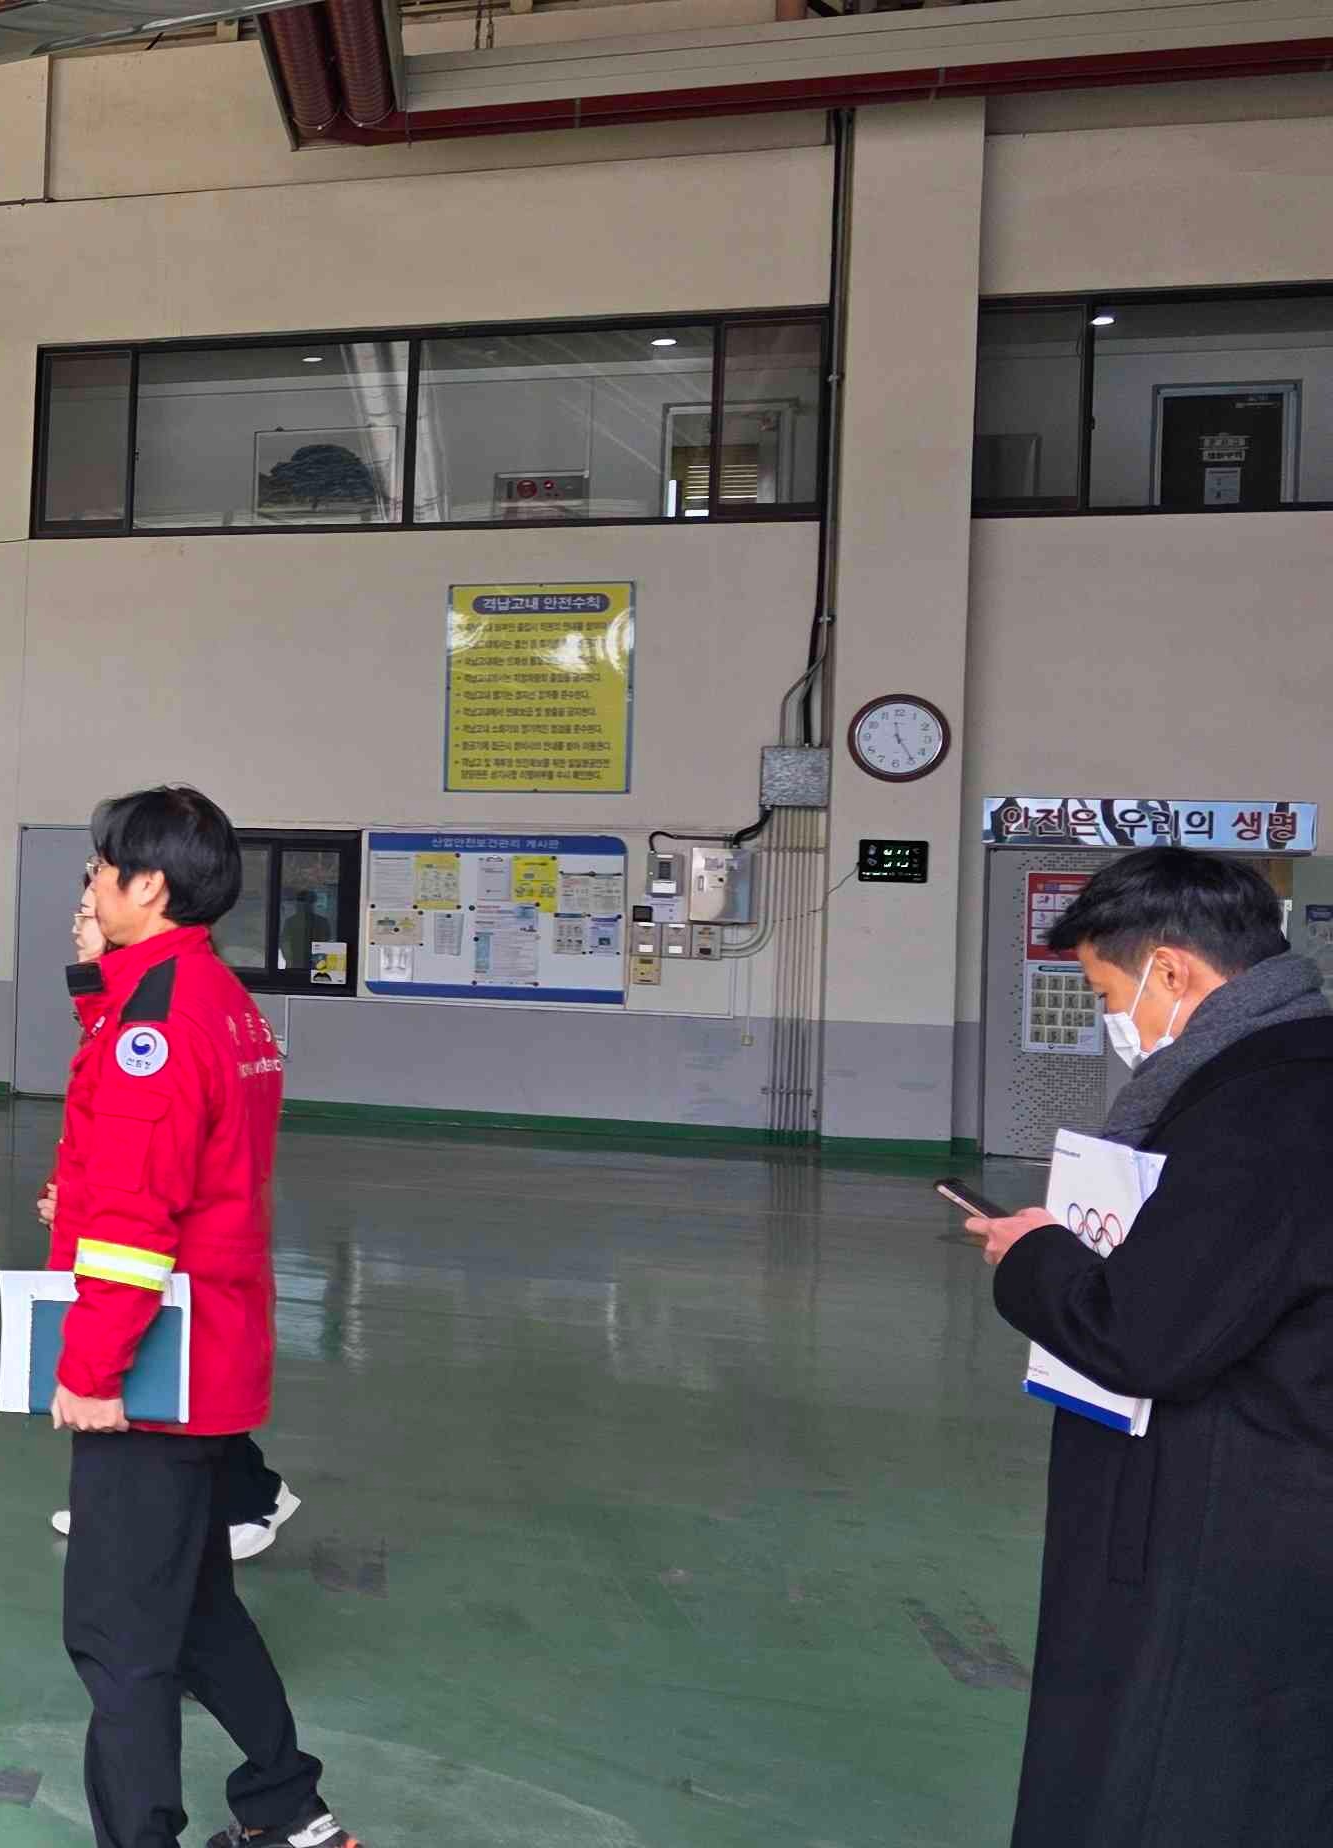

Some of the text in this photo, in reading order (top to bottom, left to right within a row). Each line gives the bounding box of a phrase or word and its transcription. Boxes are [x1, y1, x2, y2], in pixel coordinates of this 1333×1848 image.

[544, 596, 600, 610] 안전수칙
[1003, 807, 1298, 841] 안전은 우리의 생명
